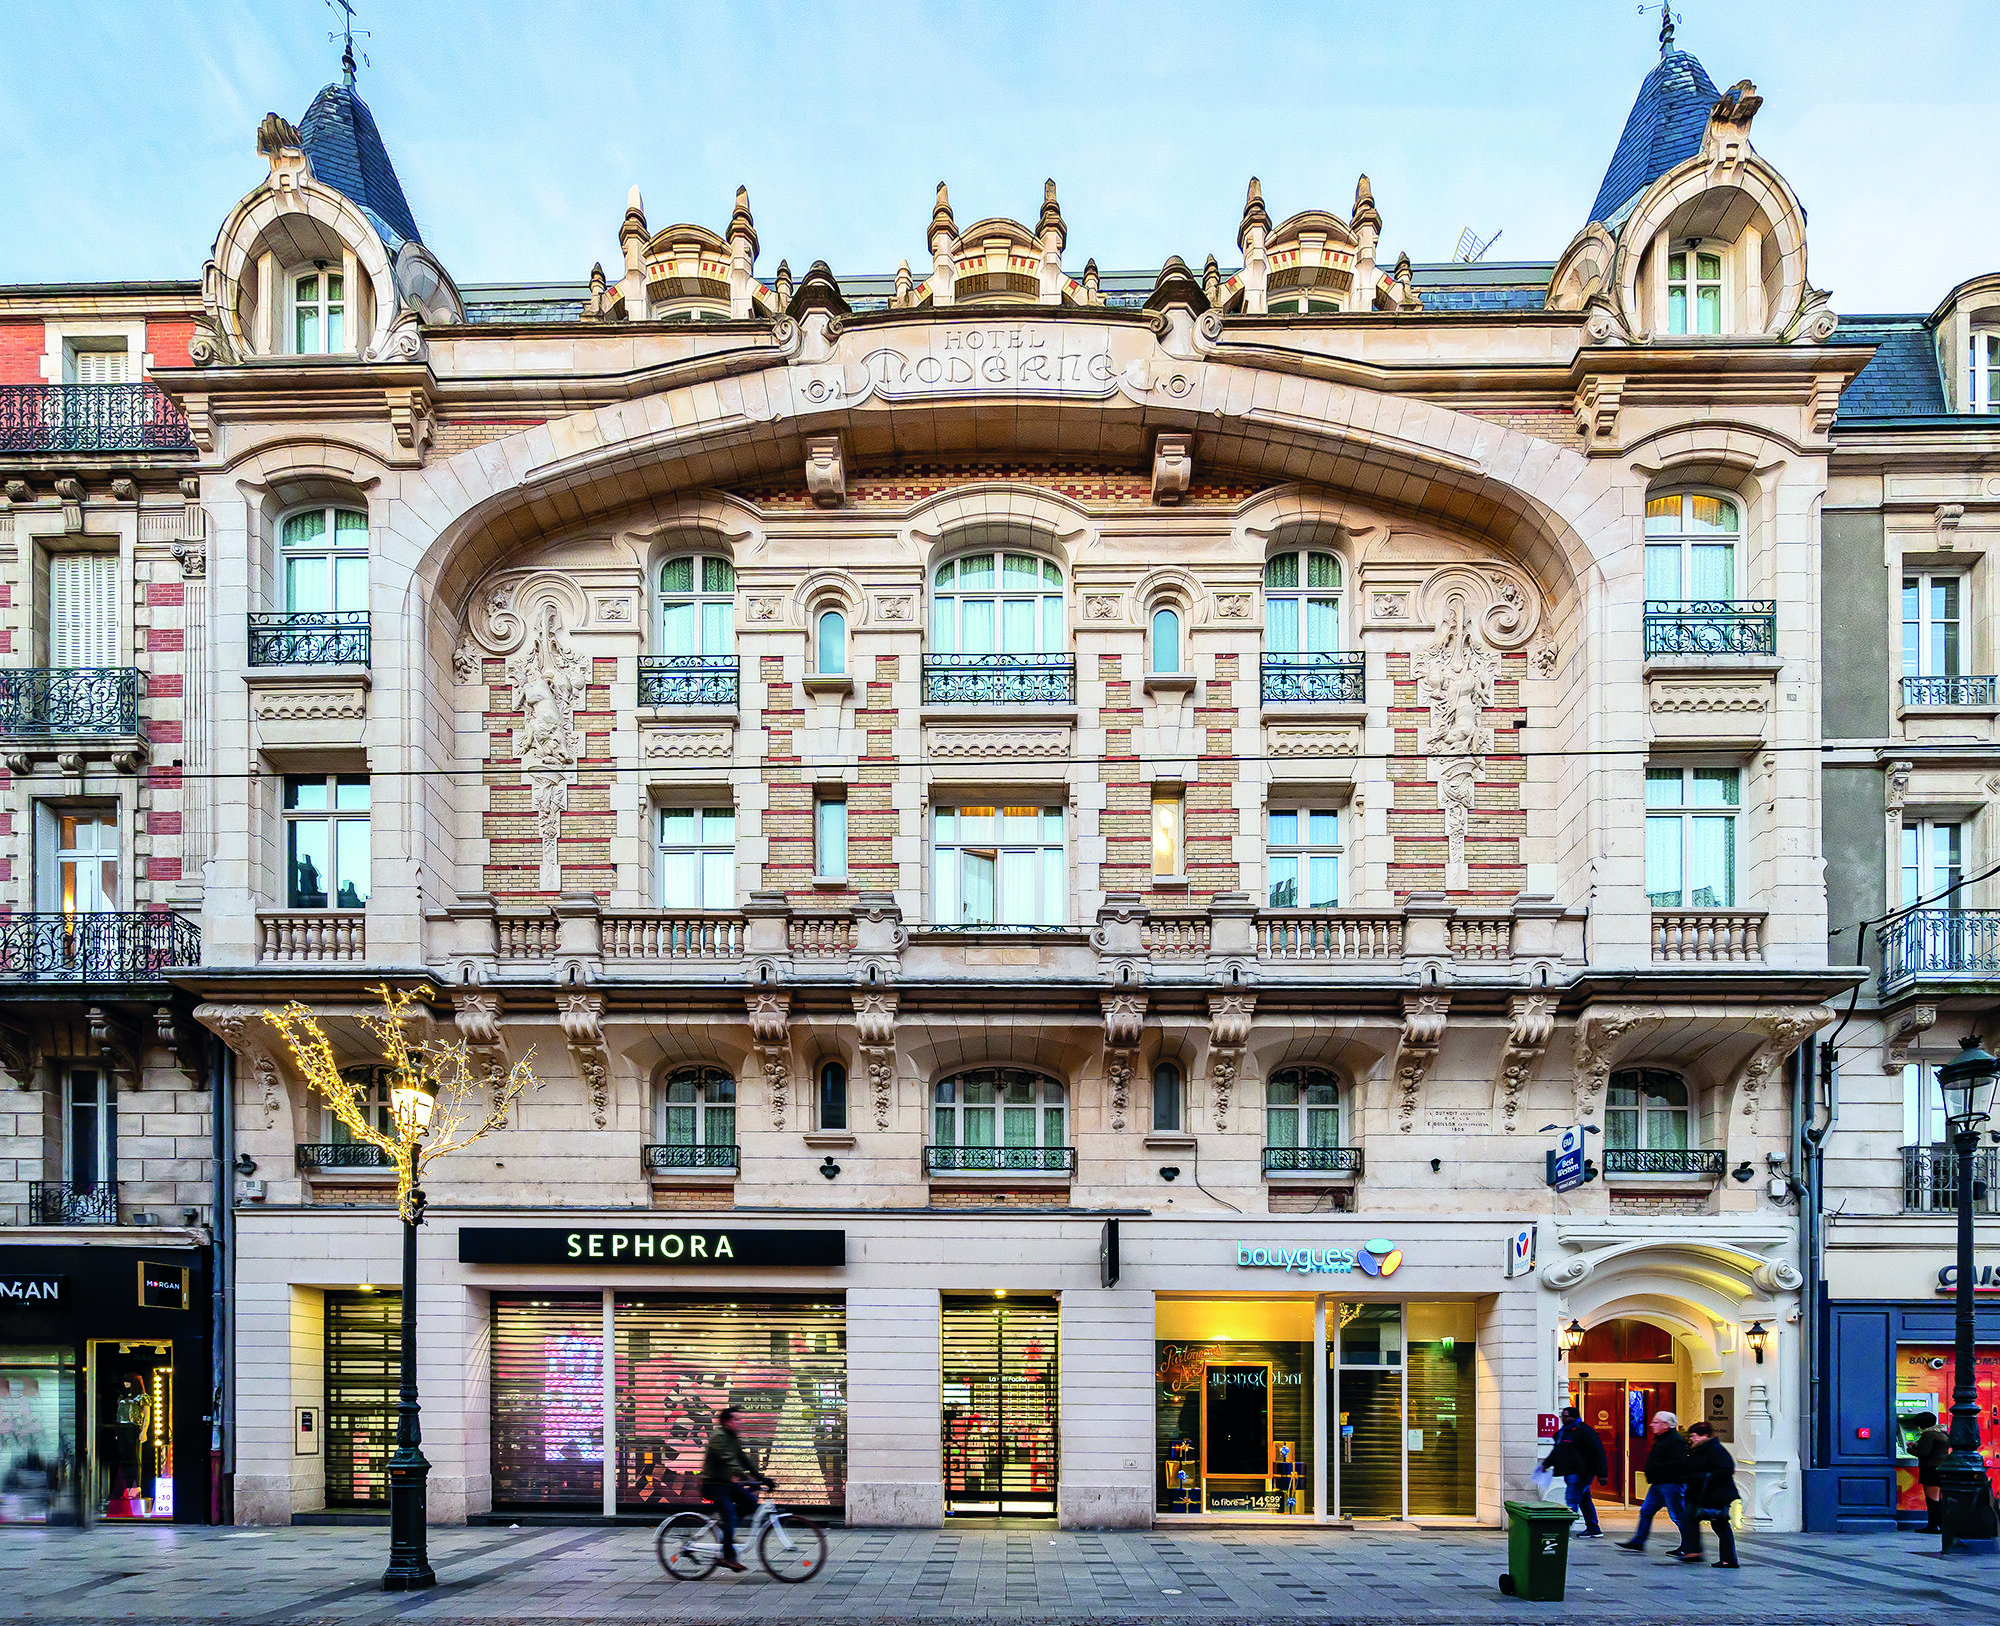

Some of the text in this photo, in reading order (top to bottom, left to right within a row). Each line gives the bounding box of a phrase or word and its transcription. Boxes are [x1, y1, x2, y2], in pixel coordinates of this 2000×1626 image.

[1561, 1157, 1574, 1169] Best
[567, 1233, 734, 1259] SEPHORA
[1236, 1239, 1354, 1273] bouygues
[1938, 1265, 2000, 1287] CI
[146, 1280, 180, 1290] MORGAN
[1545, 1418, 1556, 1427] H
[1220, 1498, 1239, 1506] fibre
